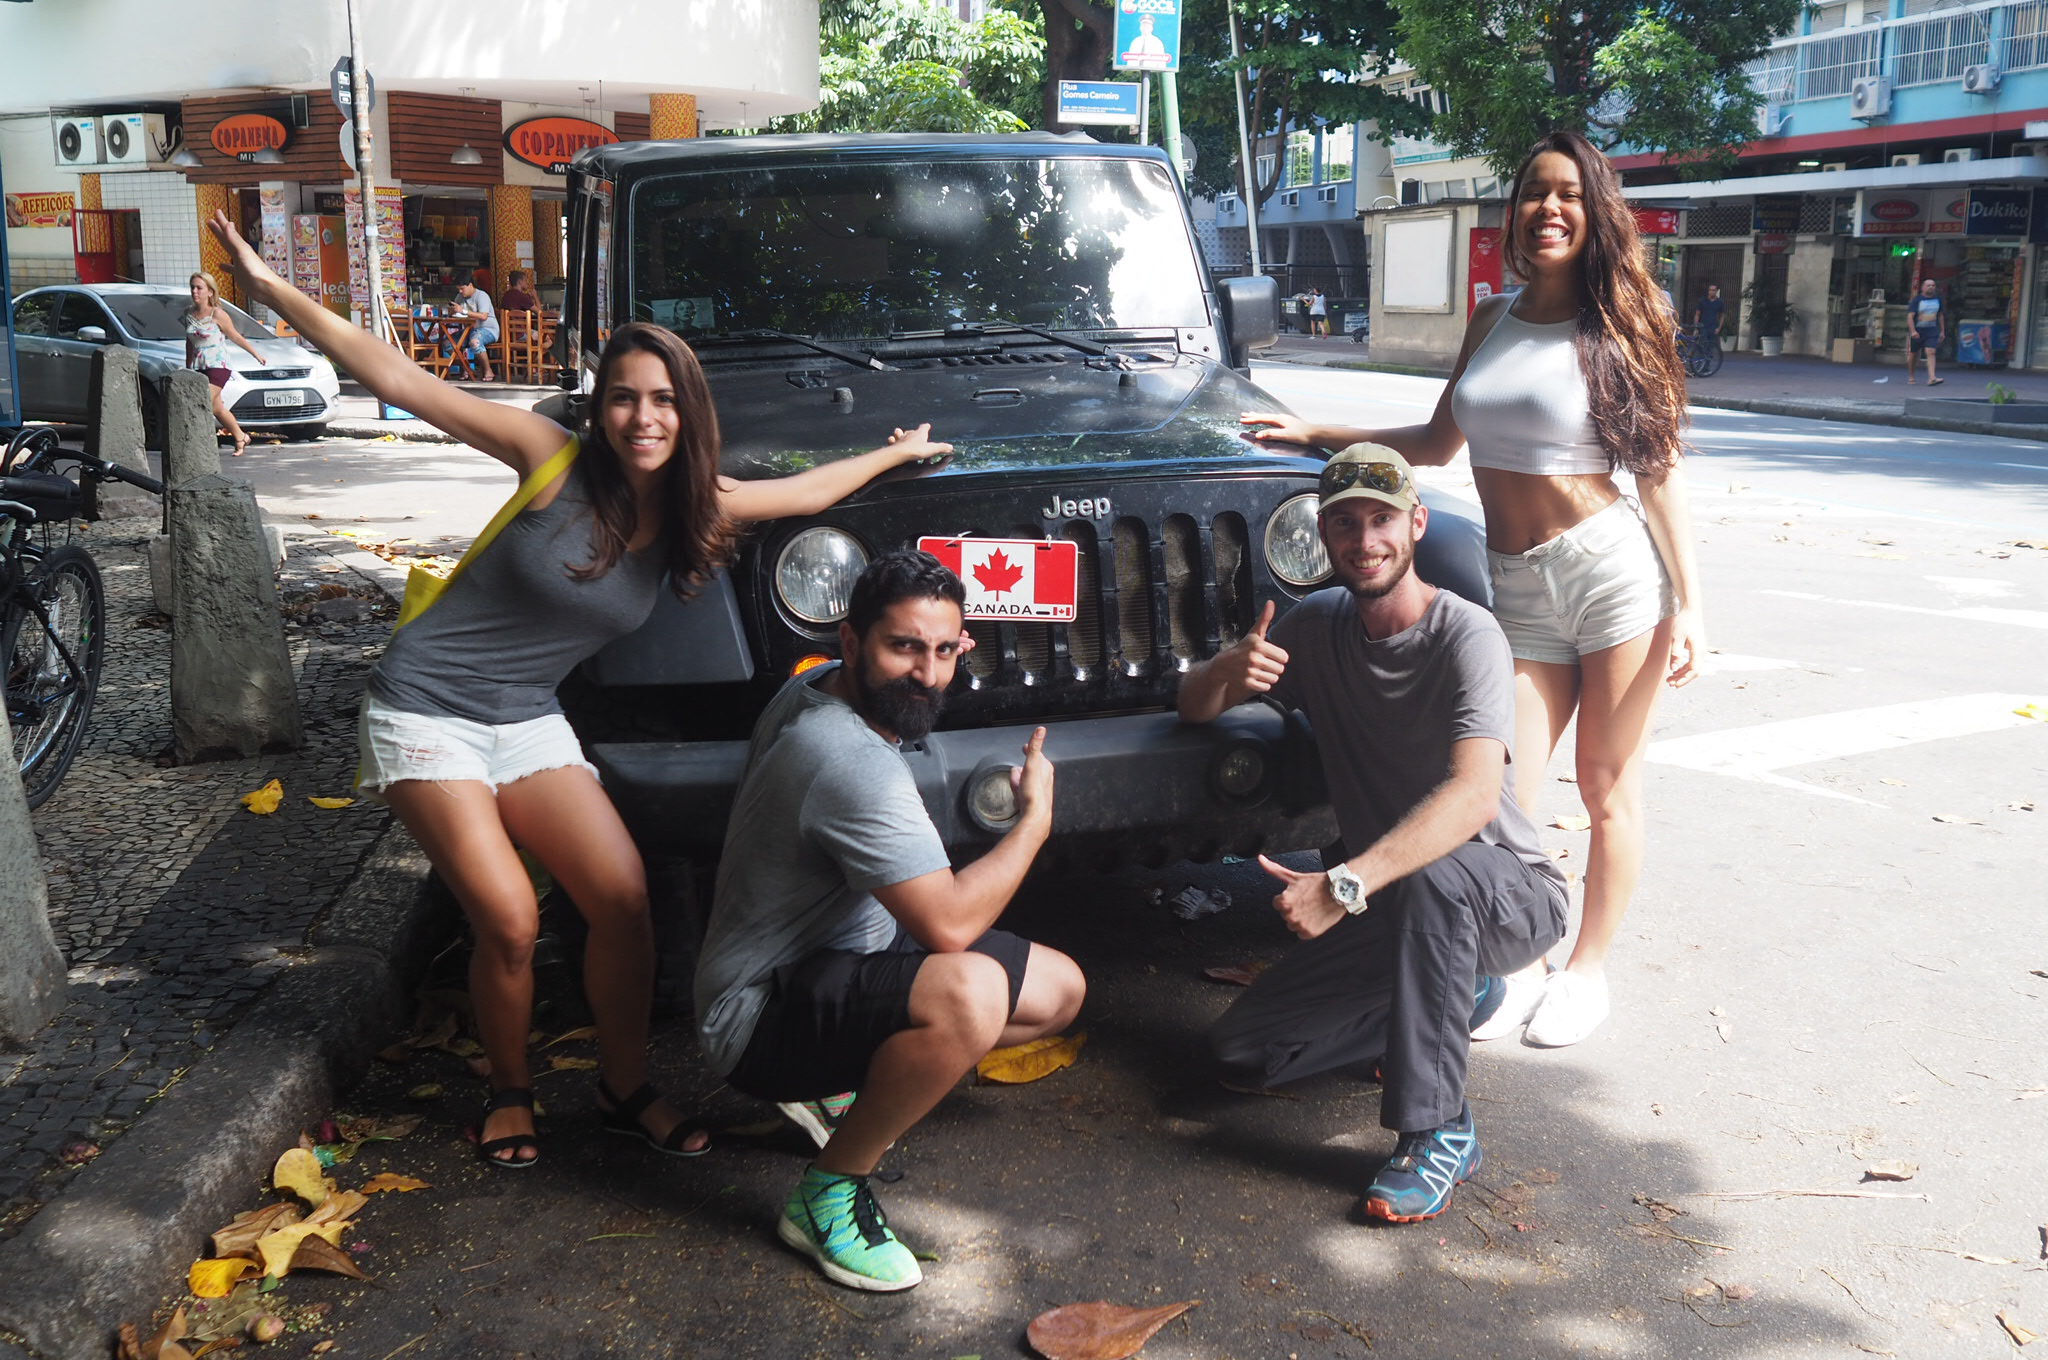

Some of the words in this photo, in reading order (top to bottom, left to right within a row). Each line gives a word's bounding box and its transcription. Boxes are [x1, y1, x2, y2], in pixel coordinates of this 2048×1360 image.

[1063, 83, 1078, 91] Rua
[1063, 91, 1089, 99] Gomes
[217, 126, 279, 148] COPANEMA
[22, 193, 74, 214] REFEIÇÕES
[1970, 201, 2029, 218] Dukiko
[1042, 495, 1111, 520] Jeep
[964, 603, 1033, 615] CANADA
